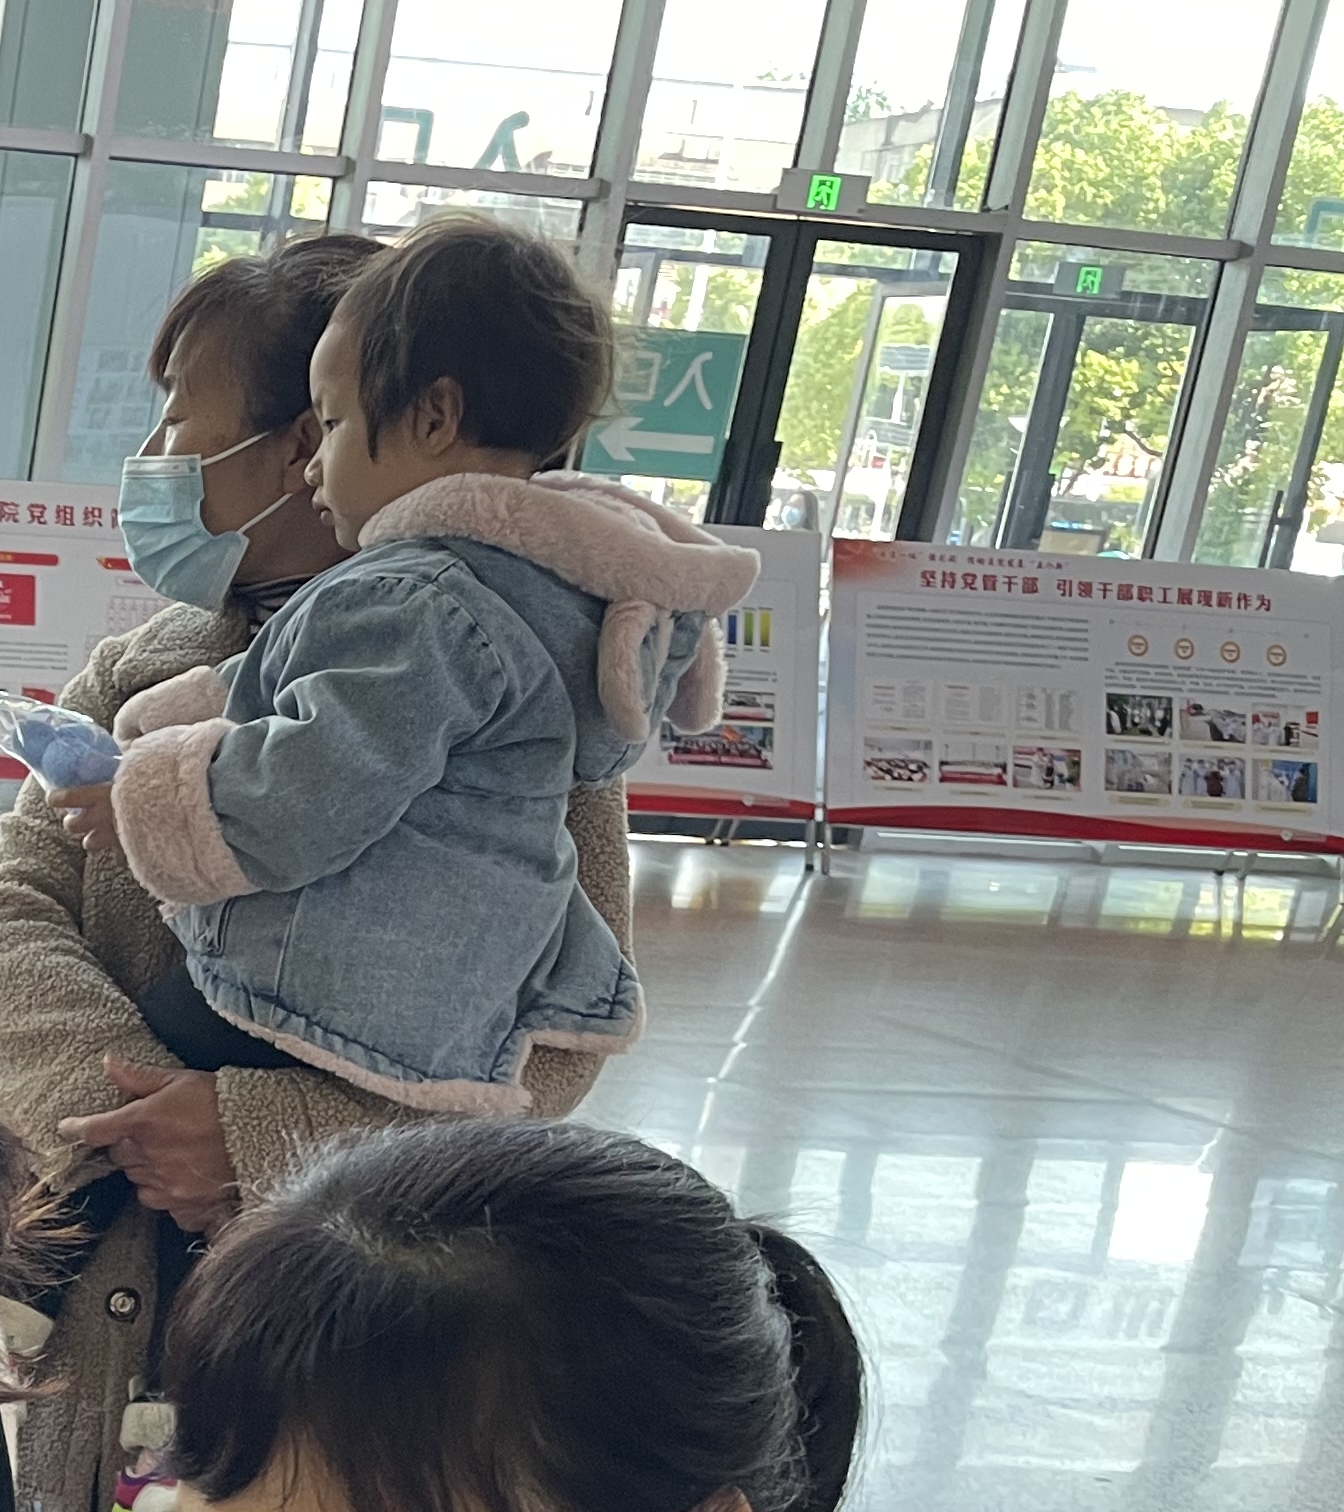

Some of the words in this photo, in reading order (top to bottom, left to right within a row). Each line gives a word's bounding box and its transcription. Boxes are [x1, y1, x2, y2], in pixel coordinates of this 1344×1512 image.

[919, 569, 1039, 595] 坚持党管干部
[1056, 578, 1272, 612] 引领干部职工展现新作为
